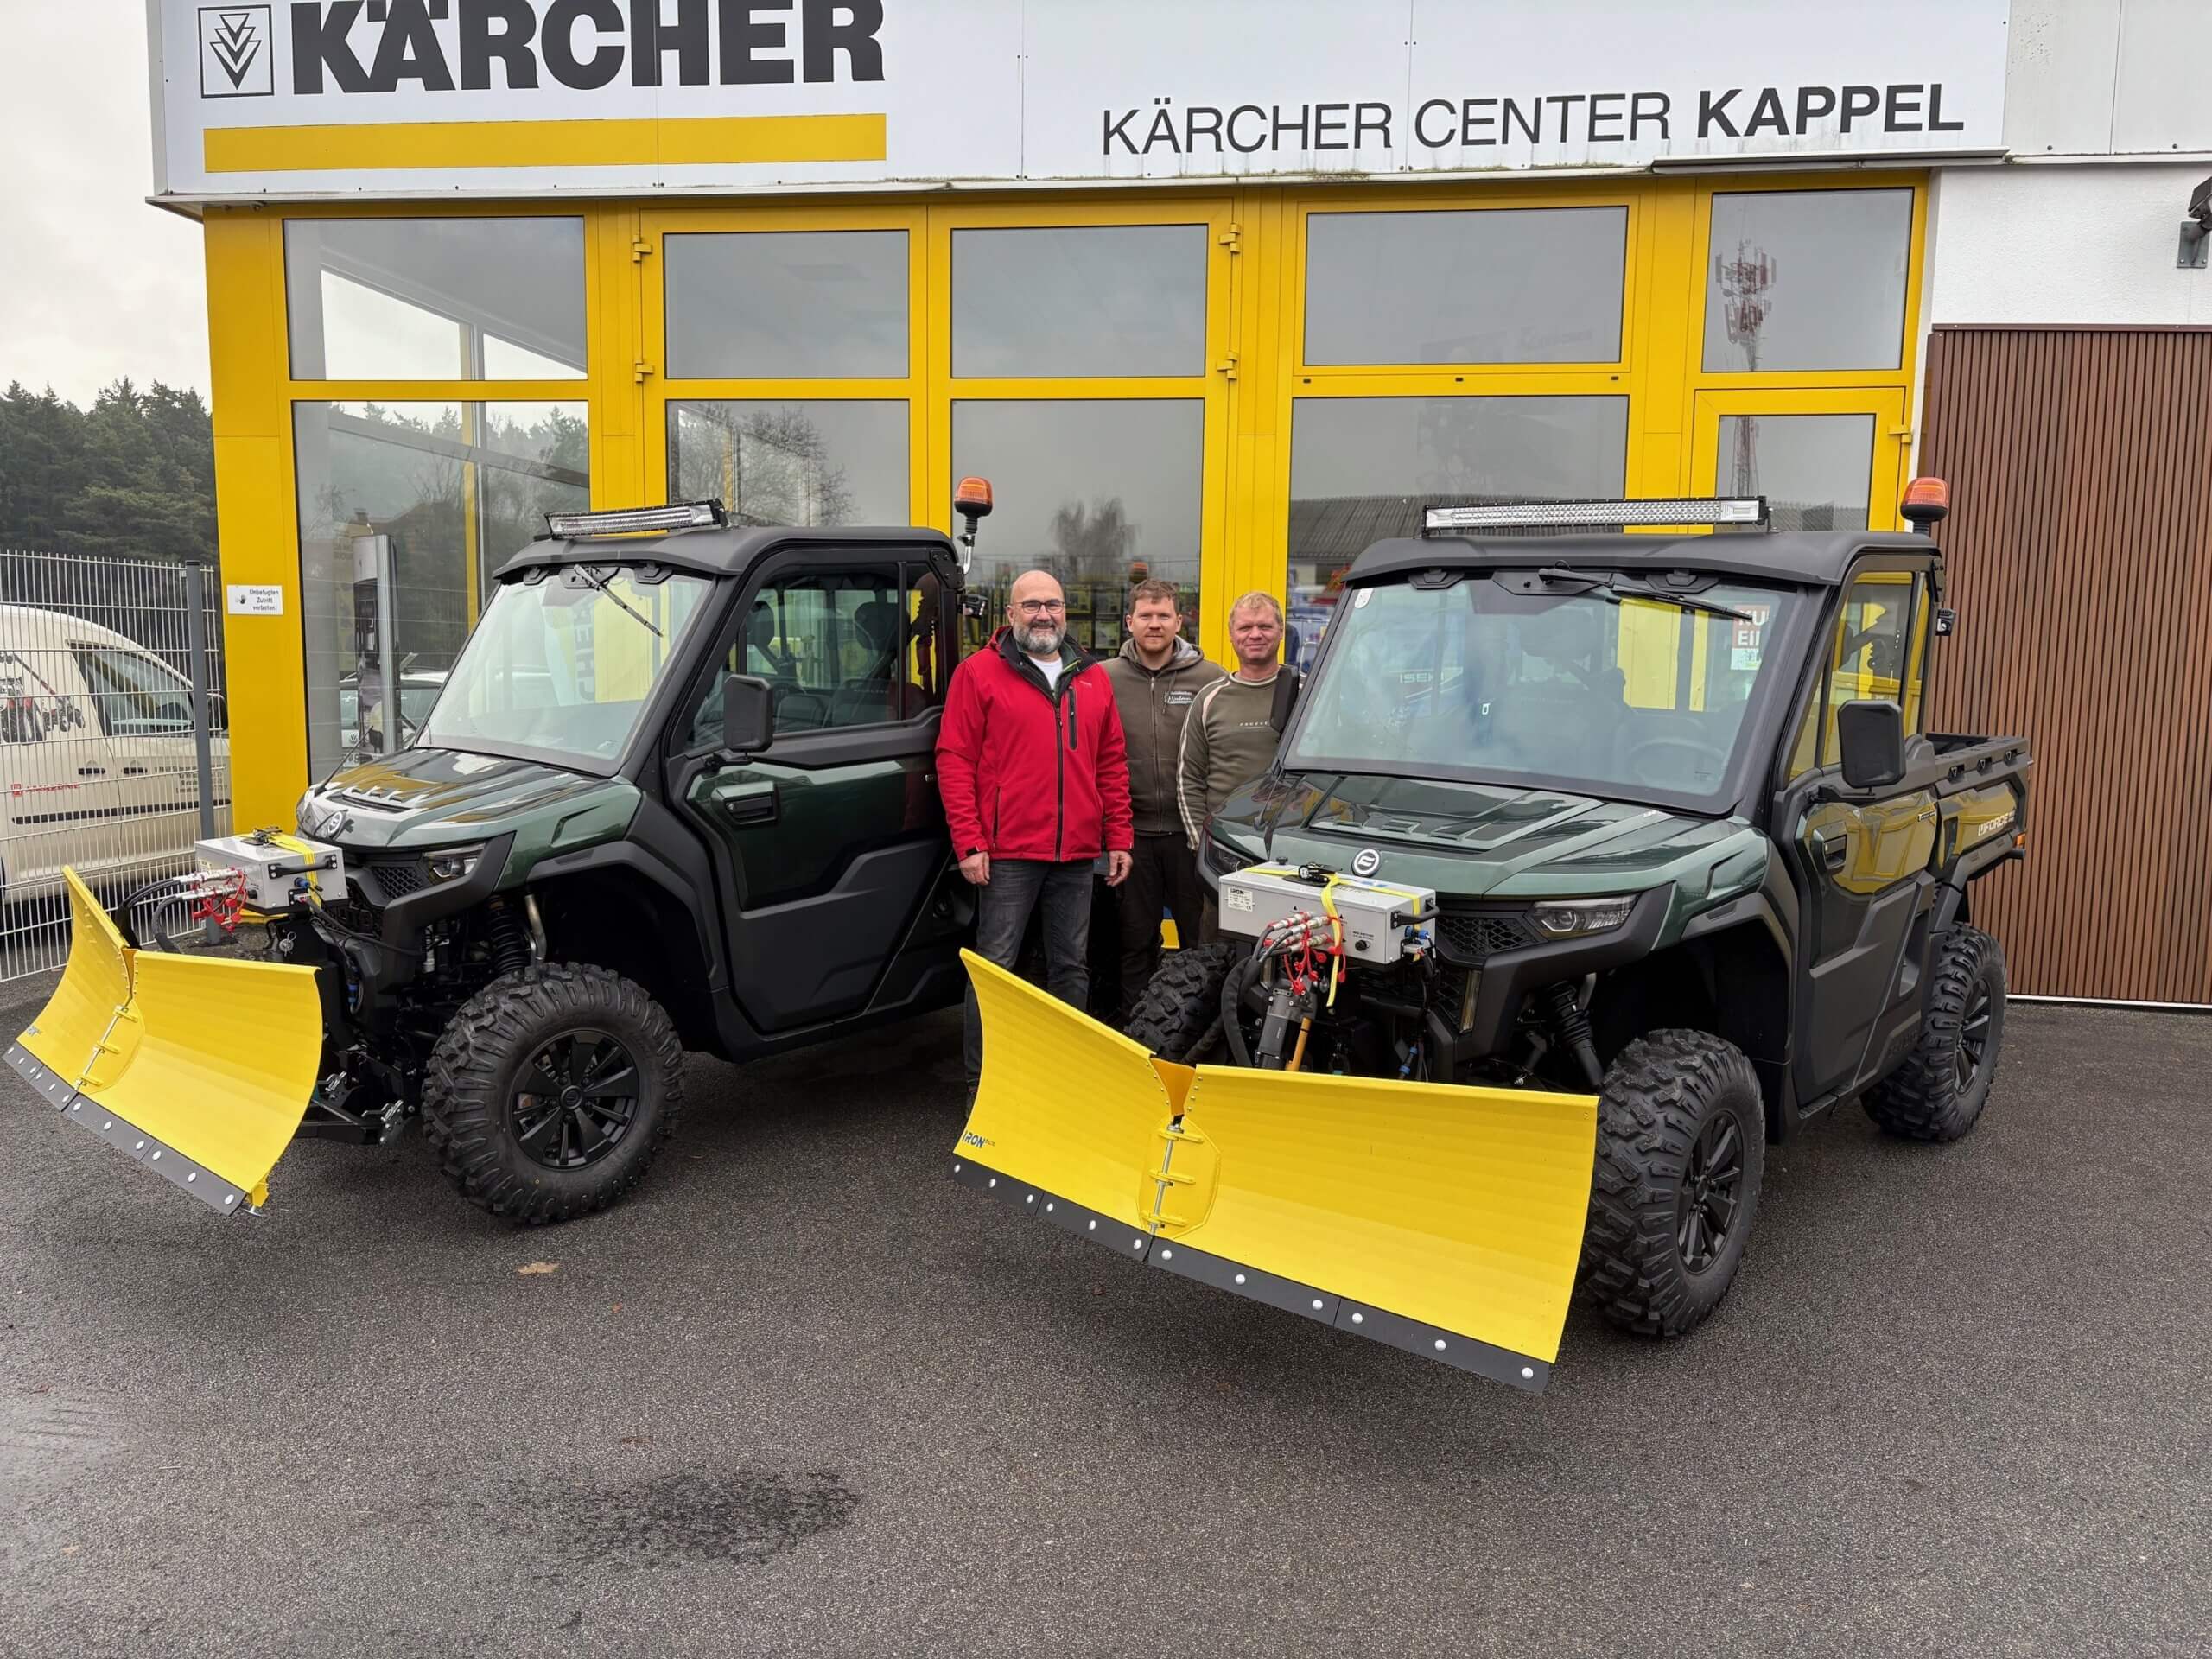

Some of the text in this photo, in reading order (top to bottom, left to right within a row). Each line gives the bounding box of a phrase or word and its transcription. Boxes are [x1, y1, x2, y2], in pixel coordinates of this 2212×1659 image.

[292, 0, 885, 94] KÄRCHER
[1103, 84, 1964, 155] KÄRCHER CENTER KAPPEL
